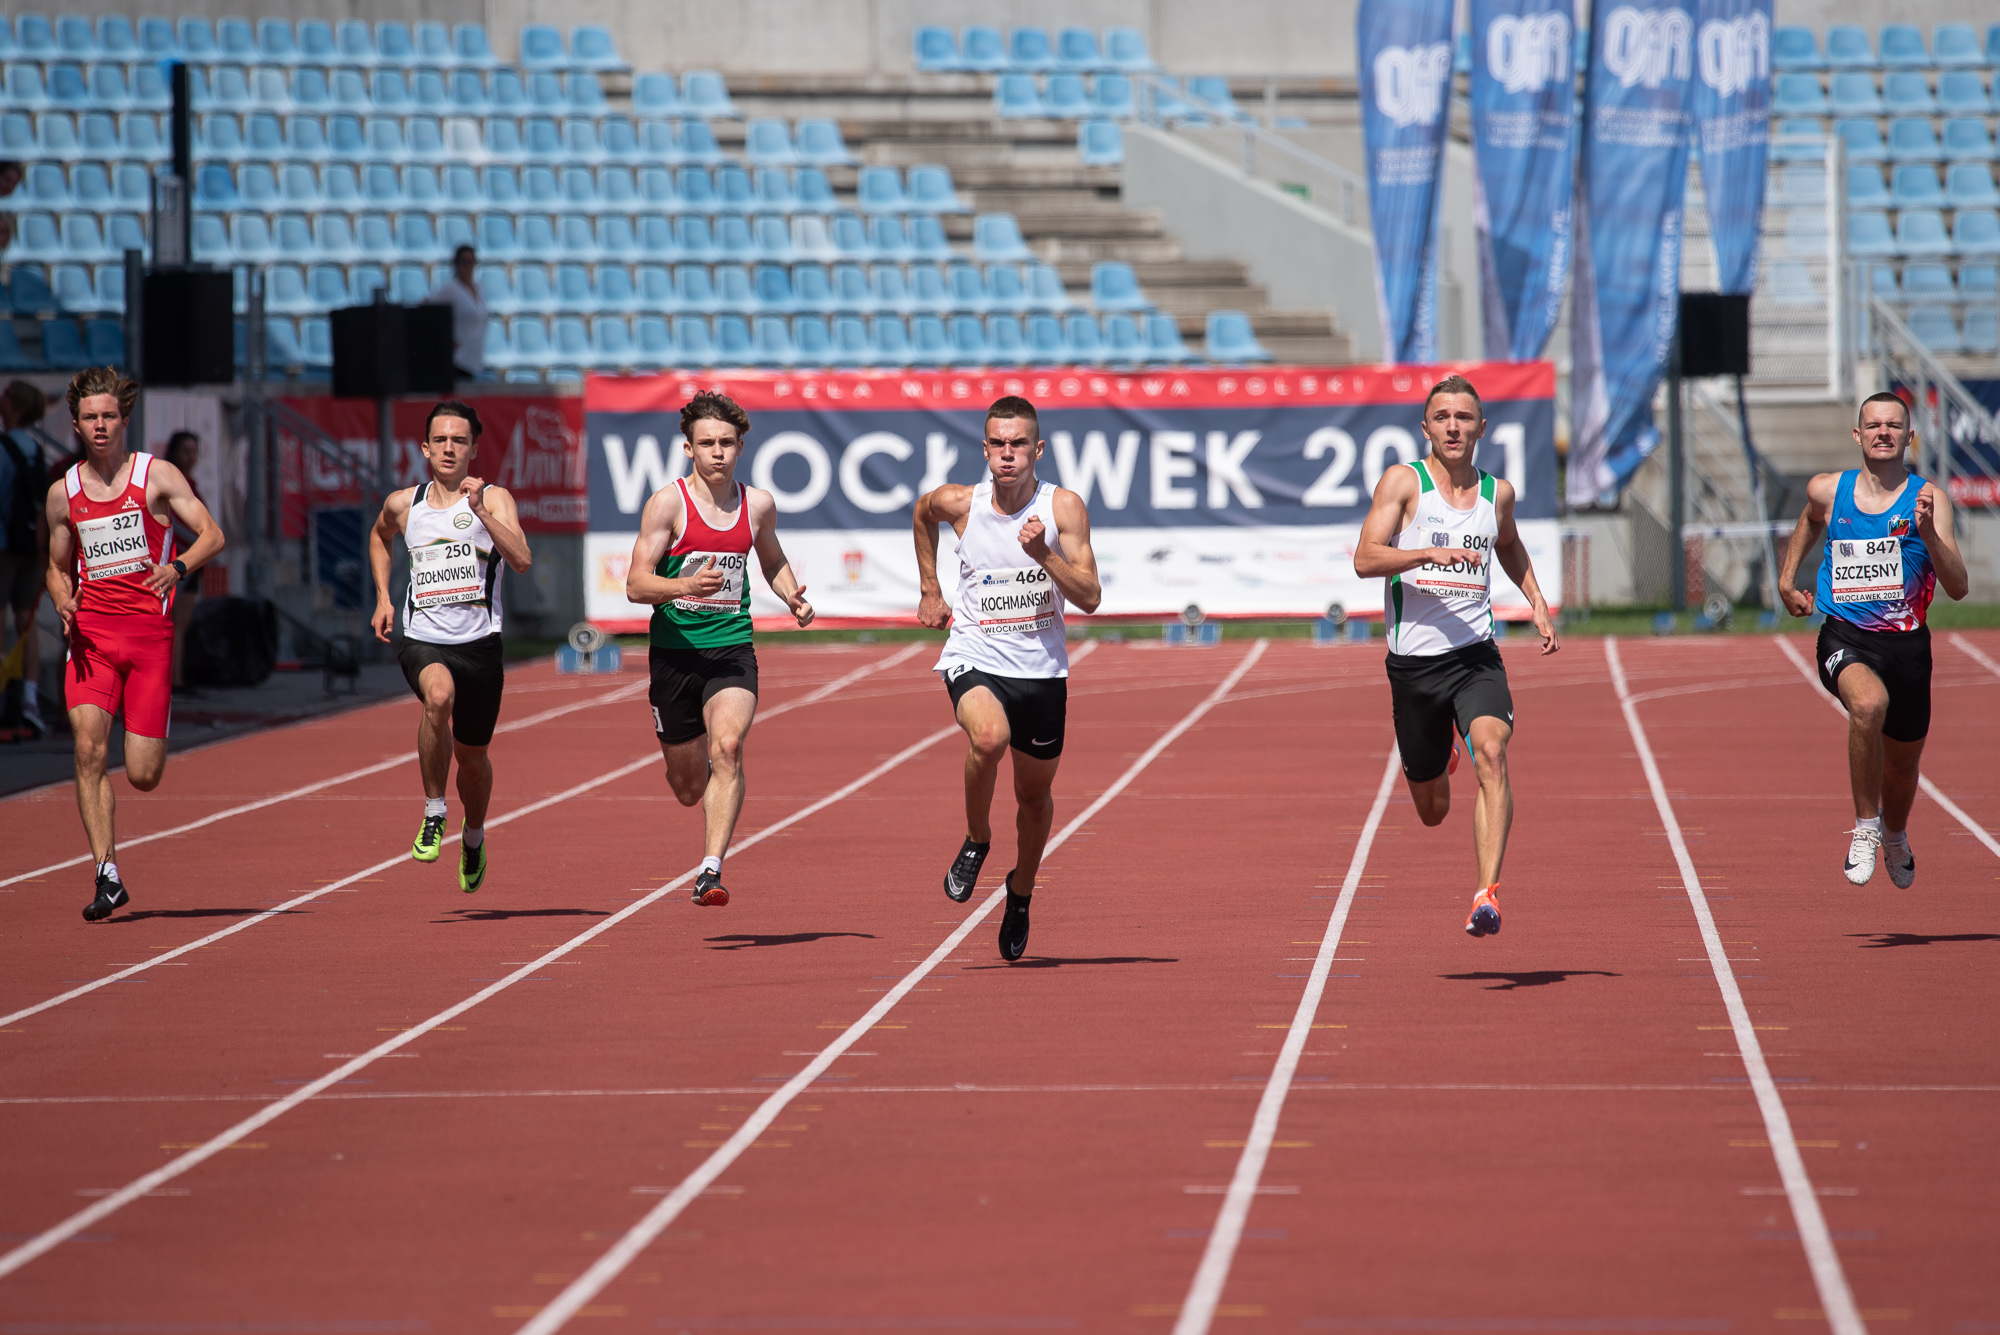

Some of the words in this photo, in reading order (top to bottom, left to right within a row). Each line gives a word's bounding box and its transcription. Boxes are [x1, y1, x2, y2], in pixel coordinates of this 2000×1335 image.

[1216, 374, 1365, 397] POLSKI
[1392, 371, 1461, 392] U1
[602, 430, 1265, 514] WOCŁWEK
[1302, 422, 1526, 507] 201
[112, 513, 140, 531] 327
[83, 535, 147, 559] UŚCIŃSKI
[1463, 534, 1488, 551] 804
[1866, 540, 1896, 555] 847
[445, 543, 471, 559] 250
[719, 555, 743, 569] 405
[91, 564, 134, 579] WŁOCŁAWEK
[416, 565, 476, 586] CZOŁNOWSKI
[1016, 568, 1047, 584] 466
[1835, 562, 1899, 581] SZCZĘSNY
[418, 594, 460, 606] WŁOCŁAWEK
[461, 592, 477, 601] 2021
[1420, 587, 1470, 598] WŁOCŁAWEK
[1835, 593, 1882, 602] WŁOCŁAWEK
[1883, 591, 1900, 599] 2021
[675, 600, 720, 612] WŁOCŁAWEK
[981, 590, 1050, 612] KOCHMAŃSKI
[984, 623, 1034, 634] WŁOCŁAWEK
[1035, 619, 1052, 629] 2021
